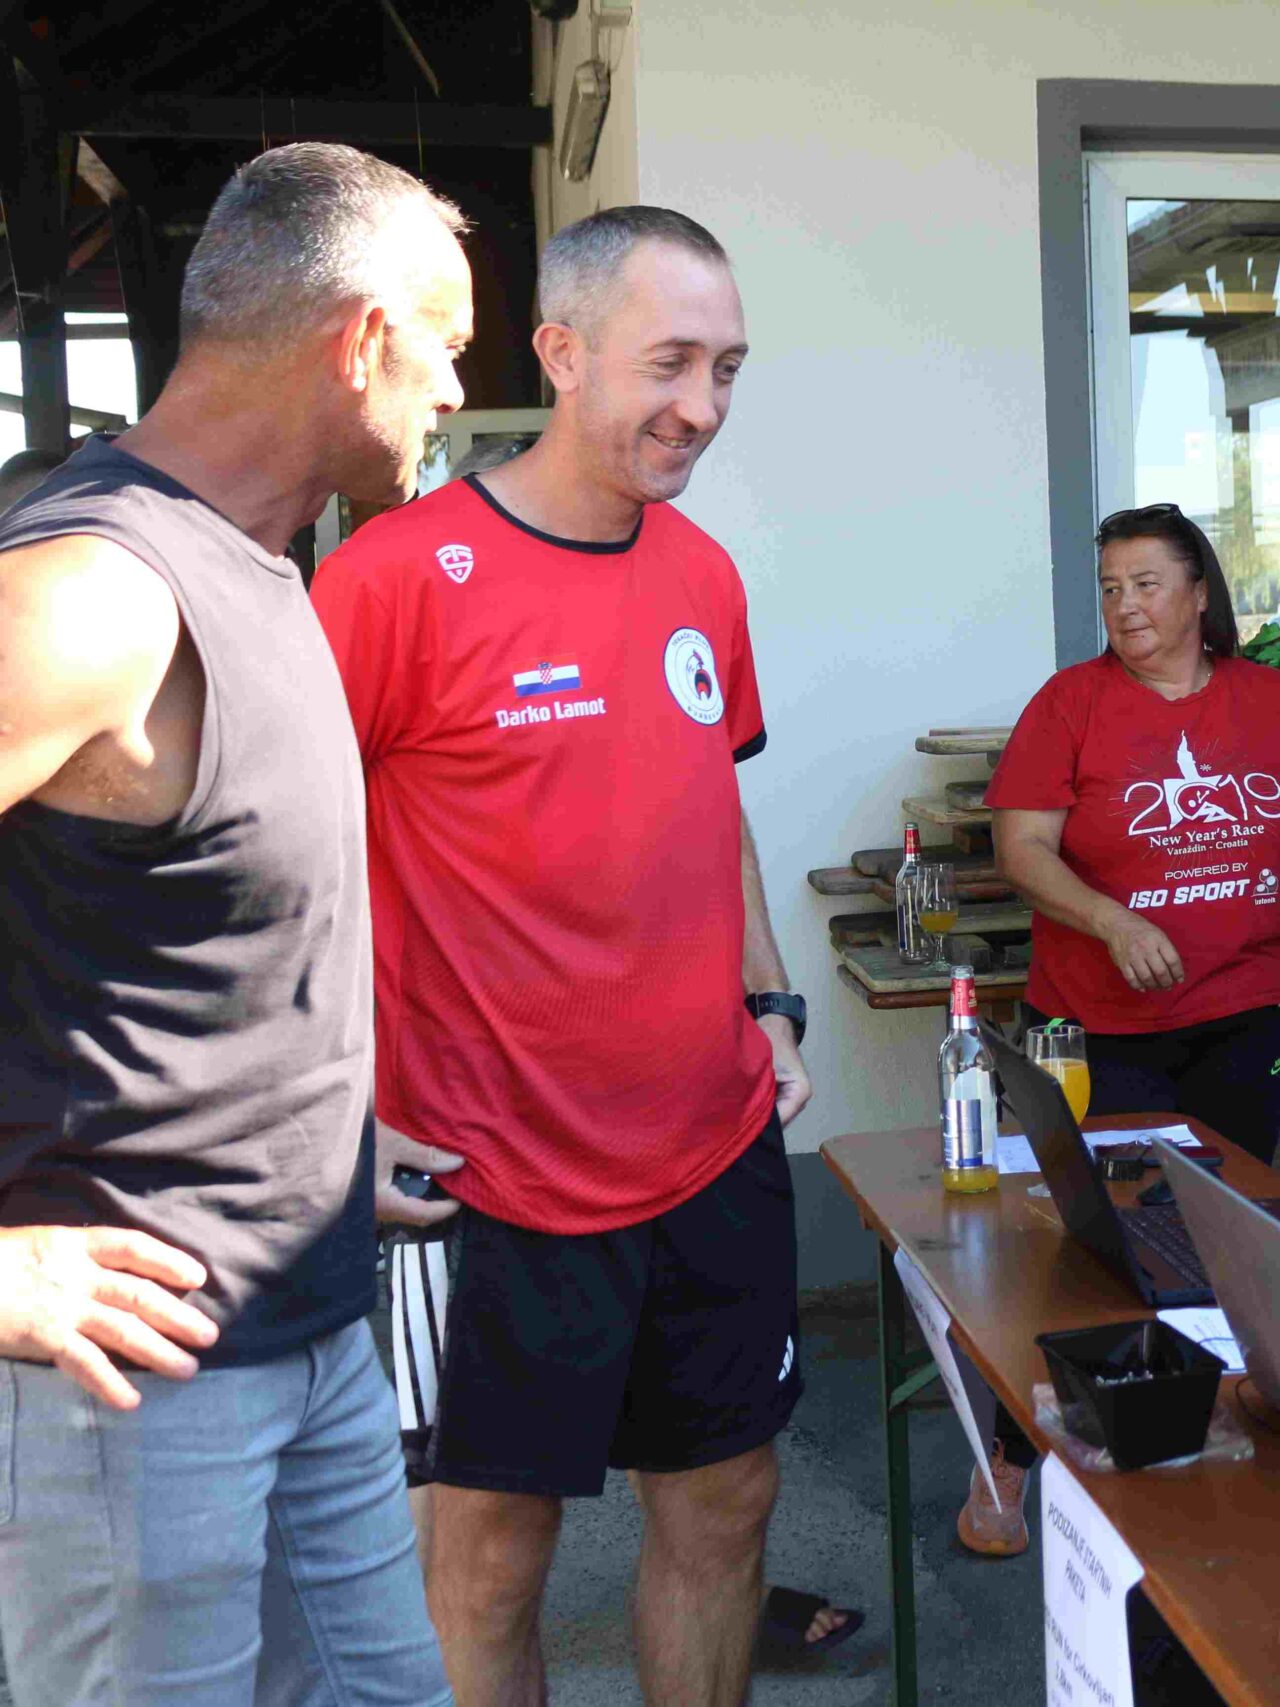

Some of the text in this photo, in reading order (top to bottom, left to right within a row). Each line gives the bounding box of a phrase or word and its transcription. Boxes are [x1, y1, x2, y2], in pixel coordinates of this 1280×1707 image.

[496, 697, 606, 728] Darko Lamot
[1150, 825, 1265, 847] New Year's Race
[1167, 844, 1206, 856] Varaždin
[1215, 839, 1248, 849] Croatia
[1165, 862, 1248, 880] POWERED BY
[1128, 879, 1251, 909] ISO SPORT
[1048, 1502, 1085, 1557] PODIZANJE
